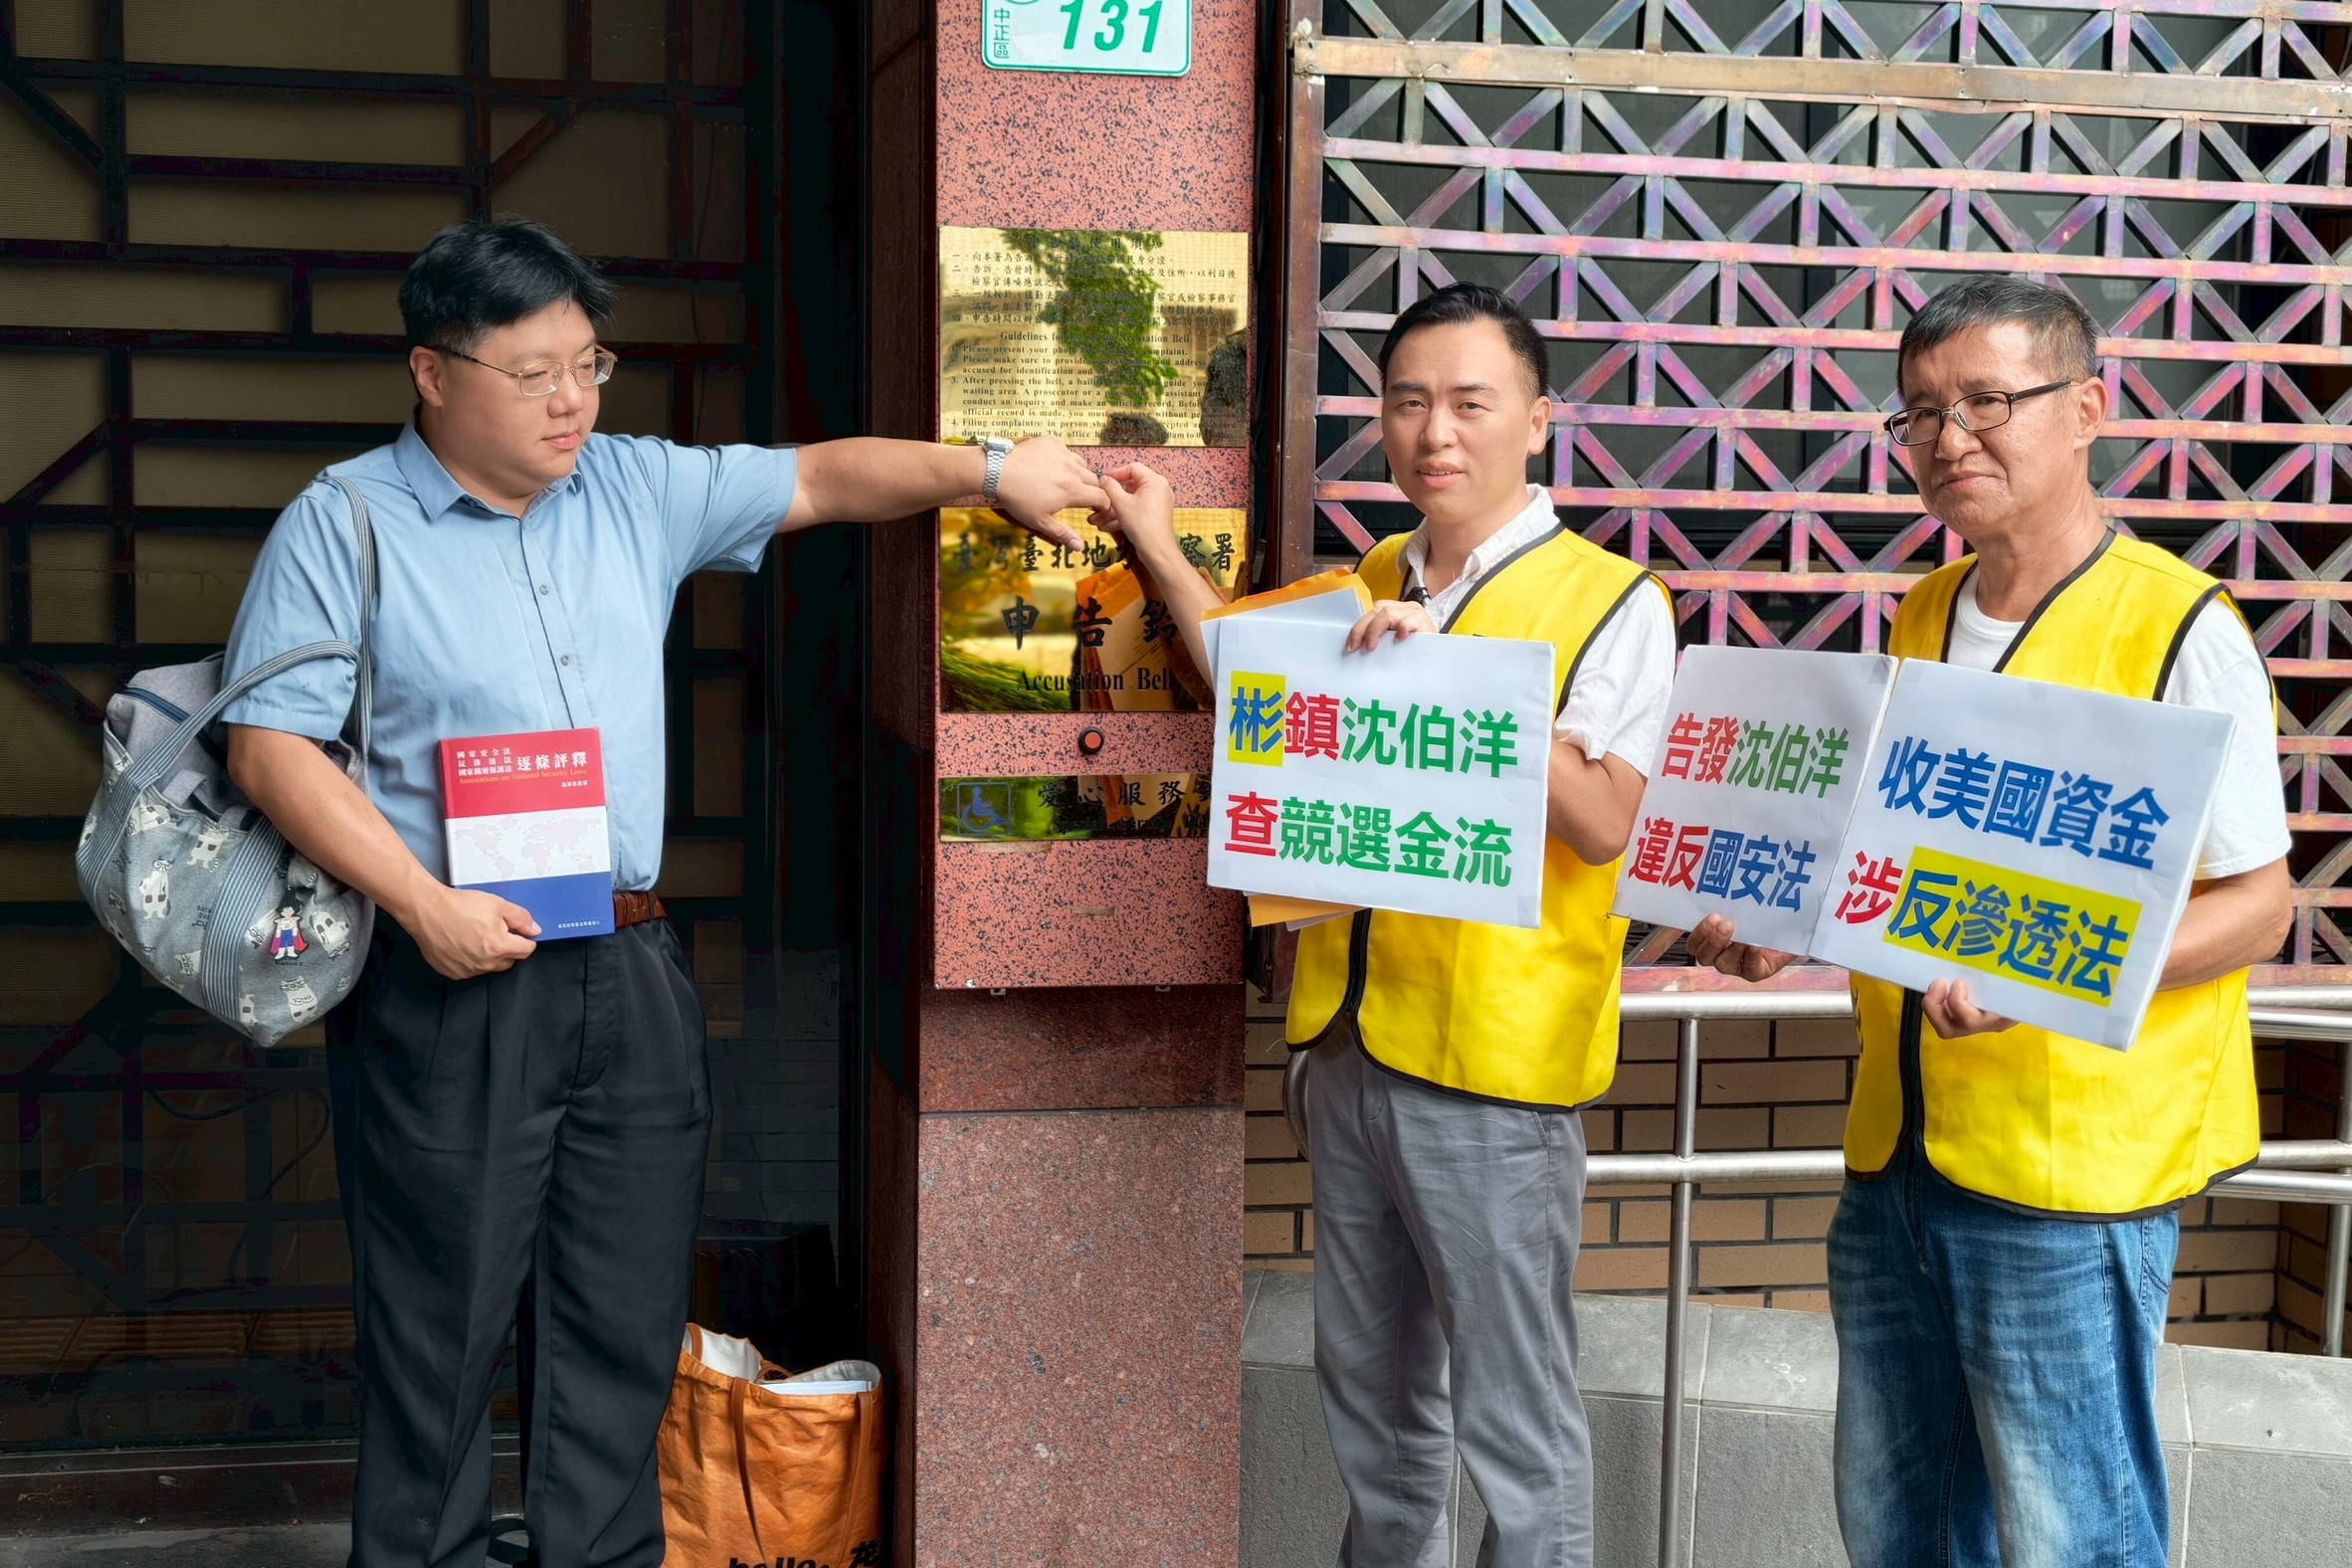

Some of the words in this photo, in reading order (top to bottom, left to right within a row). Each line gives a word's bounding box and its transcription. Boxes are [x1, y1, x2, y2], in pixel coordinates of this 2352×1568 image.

[993, 7, 1010, 58] 中正區
[1060, 0, 1163, 53] 131
[993, 345, 1025, 355] present
[1000, 331, 1048, 341] Guidelines
[1046, 377, 1065, 386] bell,
[961, 430, 990, 439] during
[962, 419, 987, 428] Filing
[1000, 595, 1178, 651] 申告鈴
[1016, 669, 1124, 691] Accusation
[1136, 668, 1175, 691] Bell
[1229, 686, 1518, 778] 彬鎮沈伯洋
[457, 747, 511, 758] 國家安全法
[516, 751, 587, 771] 逐條評釋
[1662, 711, 1850, 799] 告發沈伯洋
[540, 770, 568, 779] Security
[1878, 735, 2171, 871] 收美國資金
[1225, 792, 1512, 887] 查競選金流
[1628, 815, 1817, 912] 違反國安法
[1835, 850, 2131, 999] 涉反滲透法
